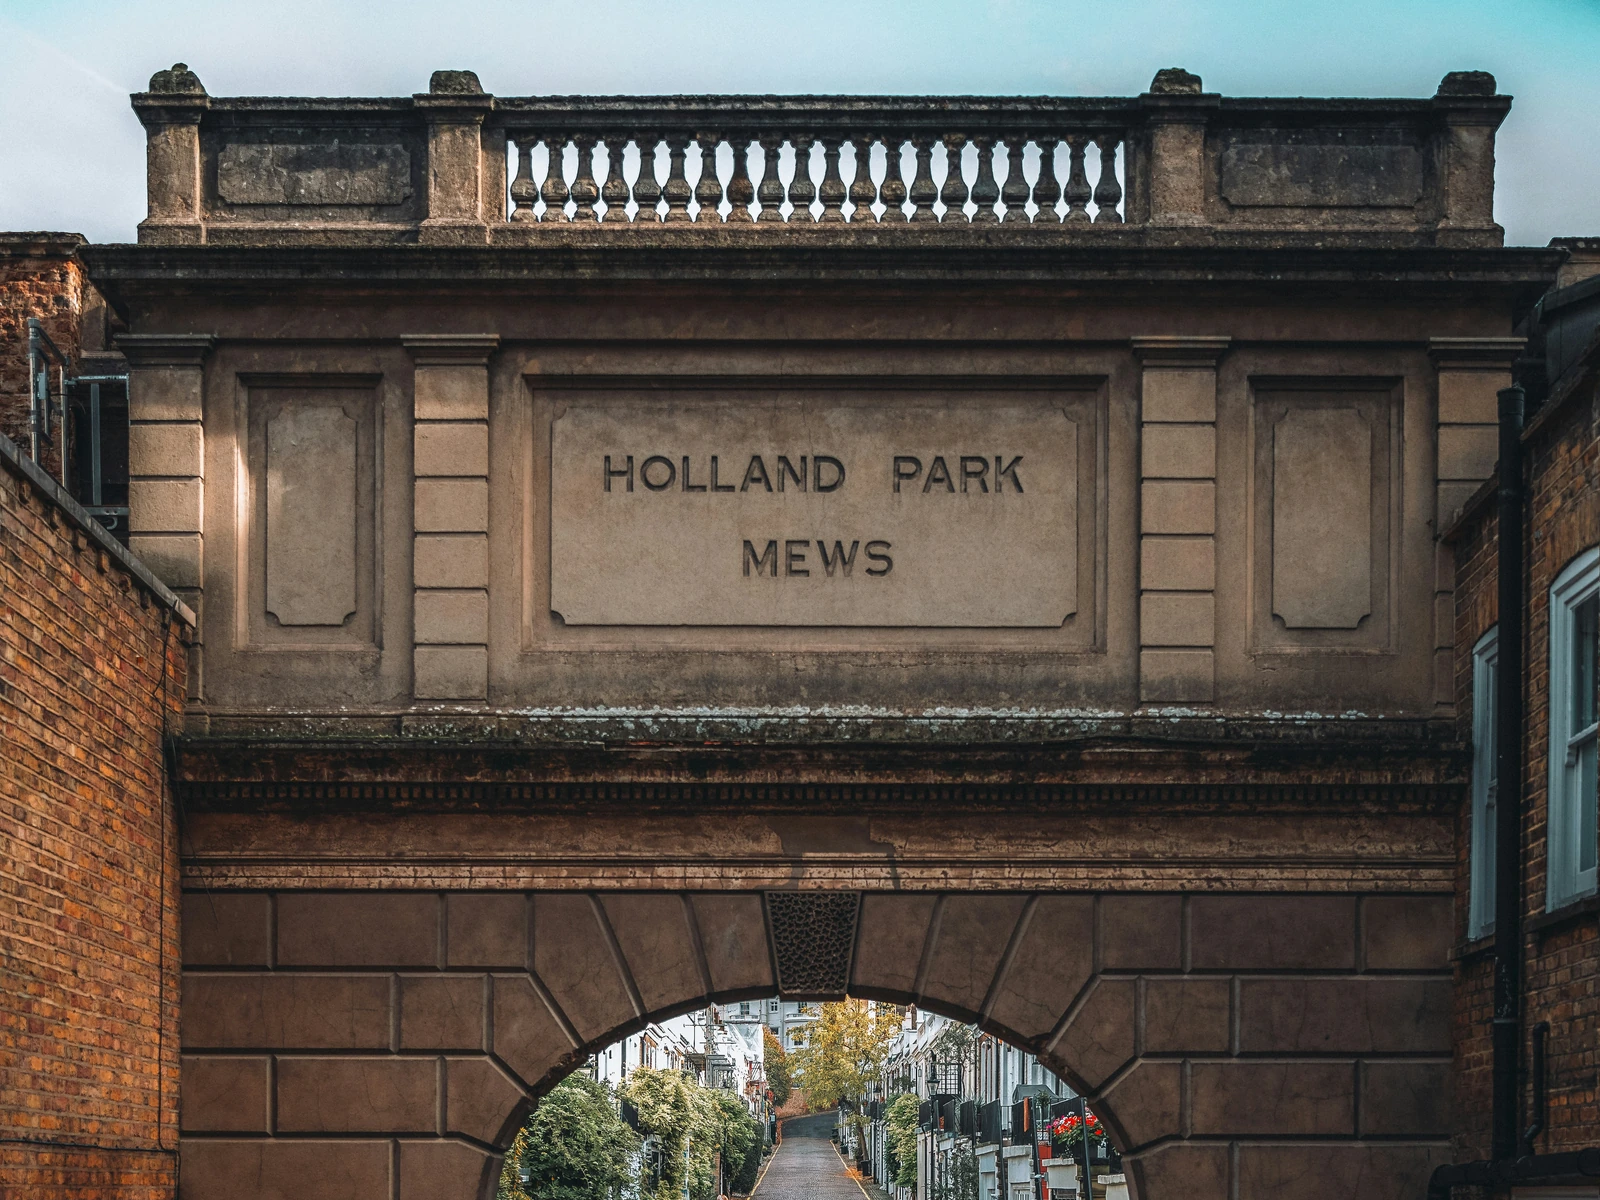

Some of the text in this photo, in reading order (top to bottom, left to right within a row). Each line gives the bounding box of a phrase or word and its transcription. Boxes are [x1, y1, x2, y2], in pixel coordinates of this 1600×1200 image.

[603, 455, 1024, 494] HOLLAND PARK
[742, 539, 893, 577] MEWS
